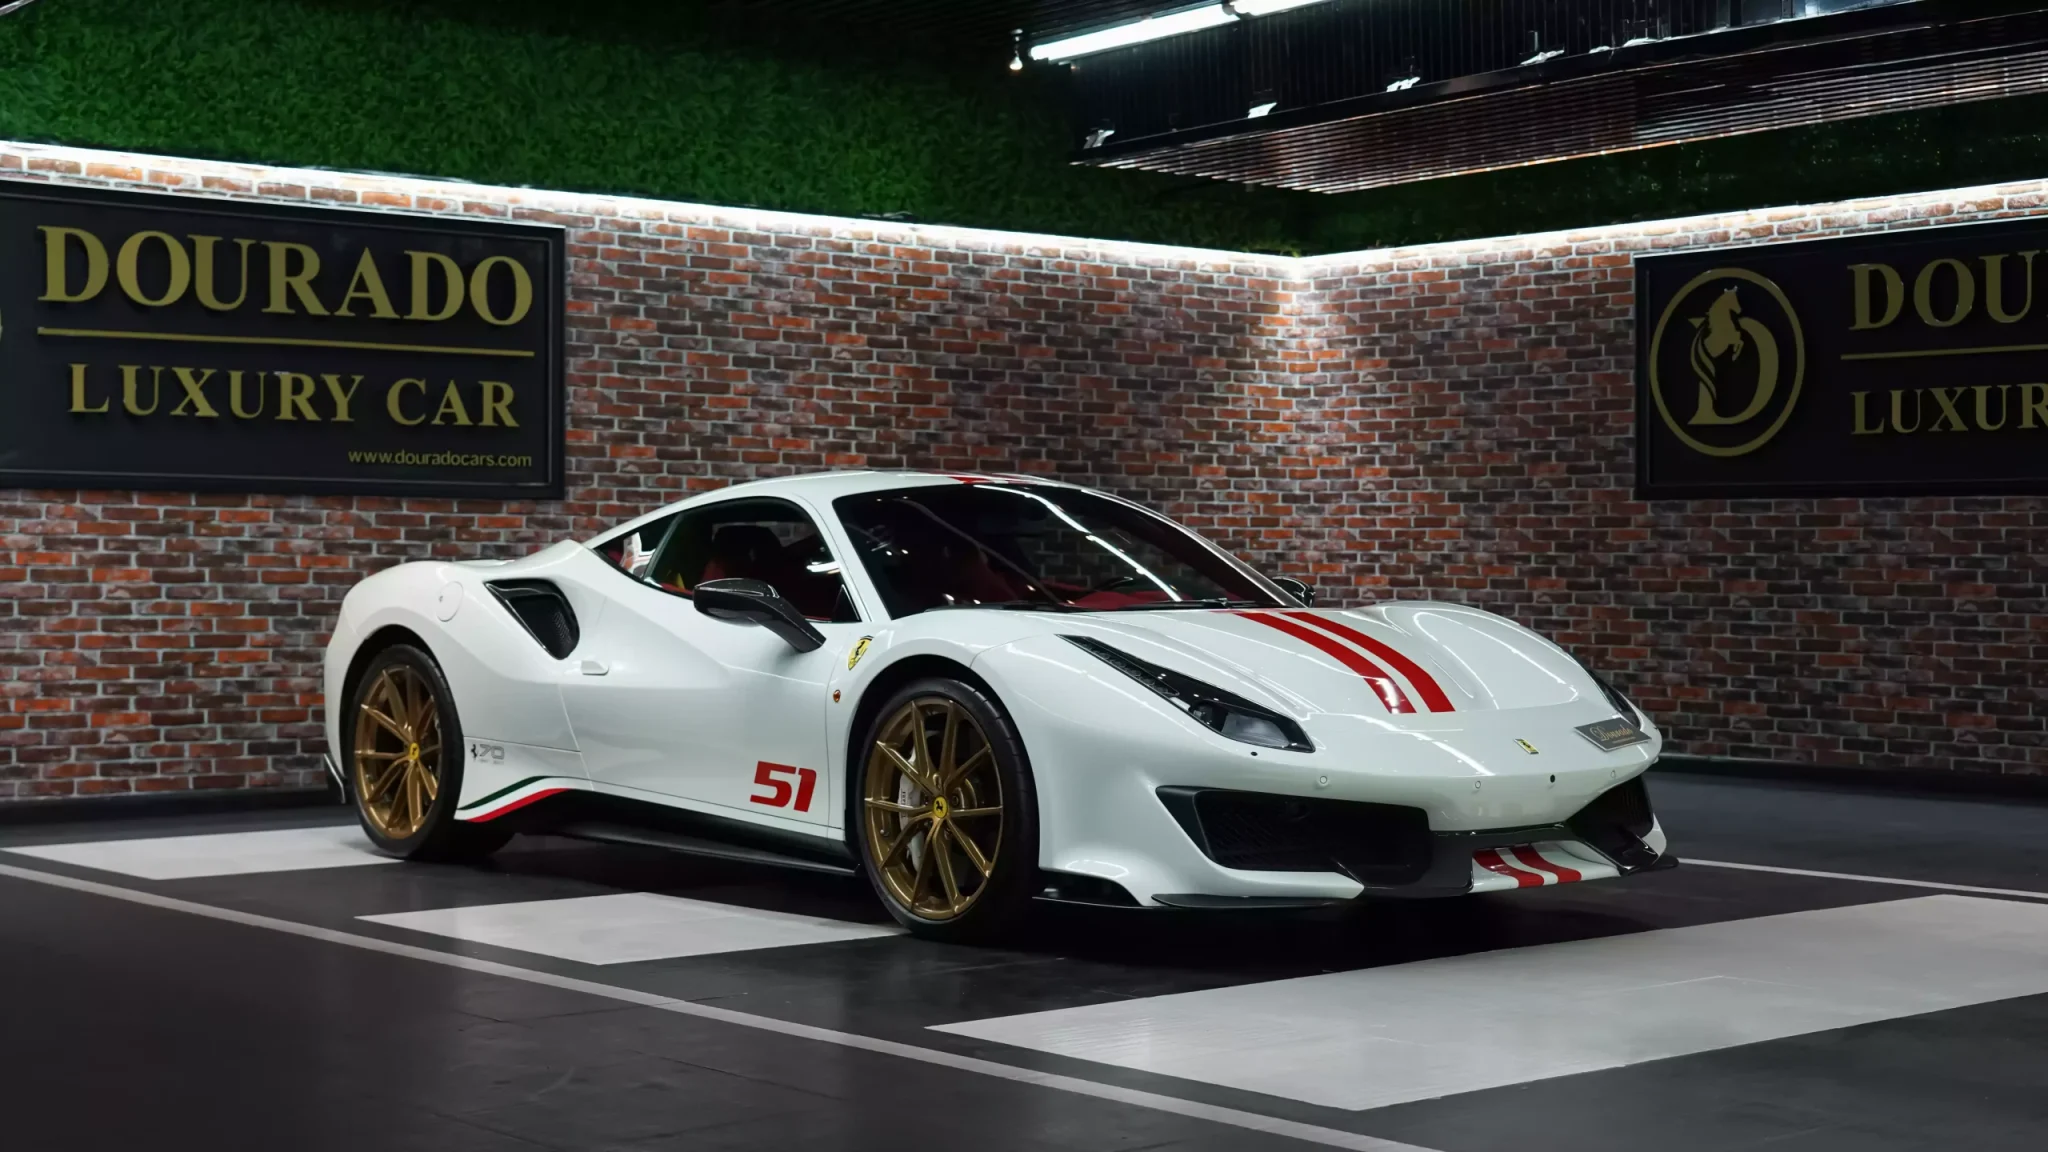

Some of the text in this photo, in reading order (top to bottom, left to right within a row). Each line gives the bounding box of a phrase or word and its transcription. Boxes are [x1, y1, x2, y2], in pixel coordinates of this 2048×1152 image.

[37, 225, 533, 326] DOURADO
[1847, 250, 2048, 330] DOU
[68, 363, 519, 428] LUXURY CAR
[348, 449, 532, 468] www.douradocars.com
[479, 743, 505, 760] 70
[750, 760, 817, 813] 51
